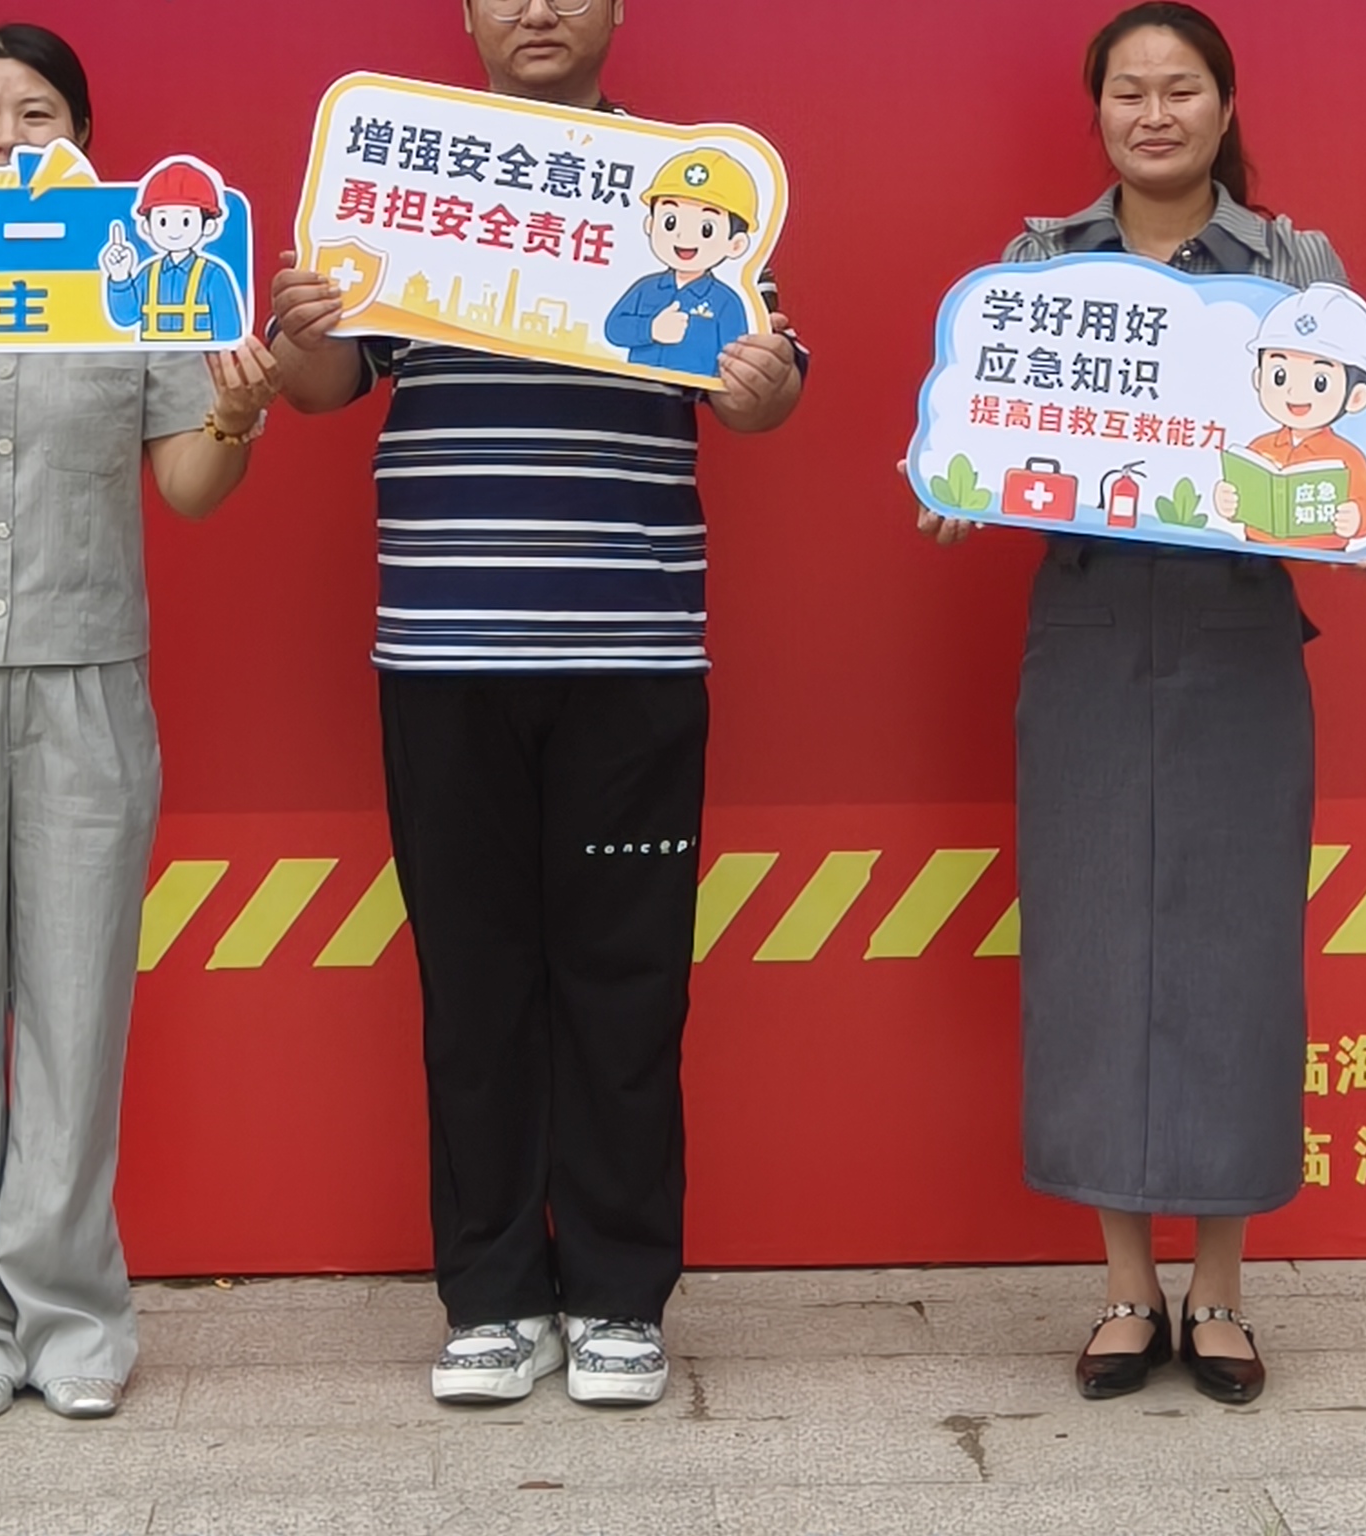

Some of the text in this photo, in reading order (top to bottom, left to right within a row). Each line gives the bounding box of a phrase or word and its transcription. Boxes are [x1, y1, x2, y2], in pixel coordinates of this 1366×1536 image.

[346, 115, 635, 208] 增强安全意识
[336, 178, 615, 266] 勇担安全责任
[982, 289, 1169, 348] 学好用好
[975, 344, 1160, 400] 应急知识
[969, 393, 1227, 451] 提高自救互救能力
